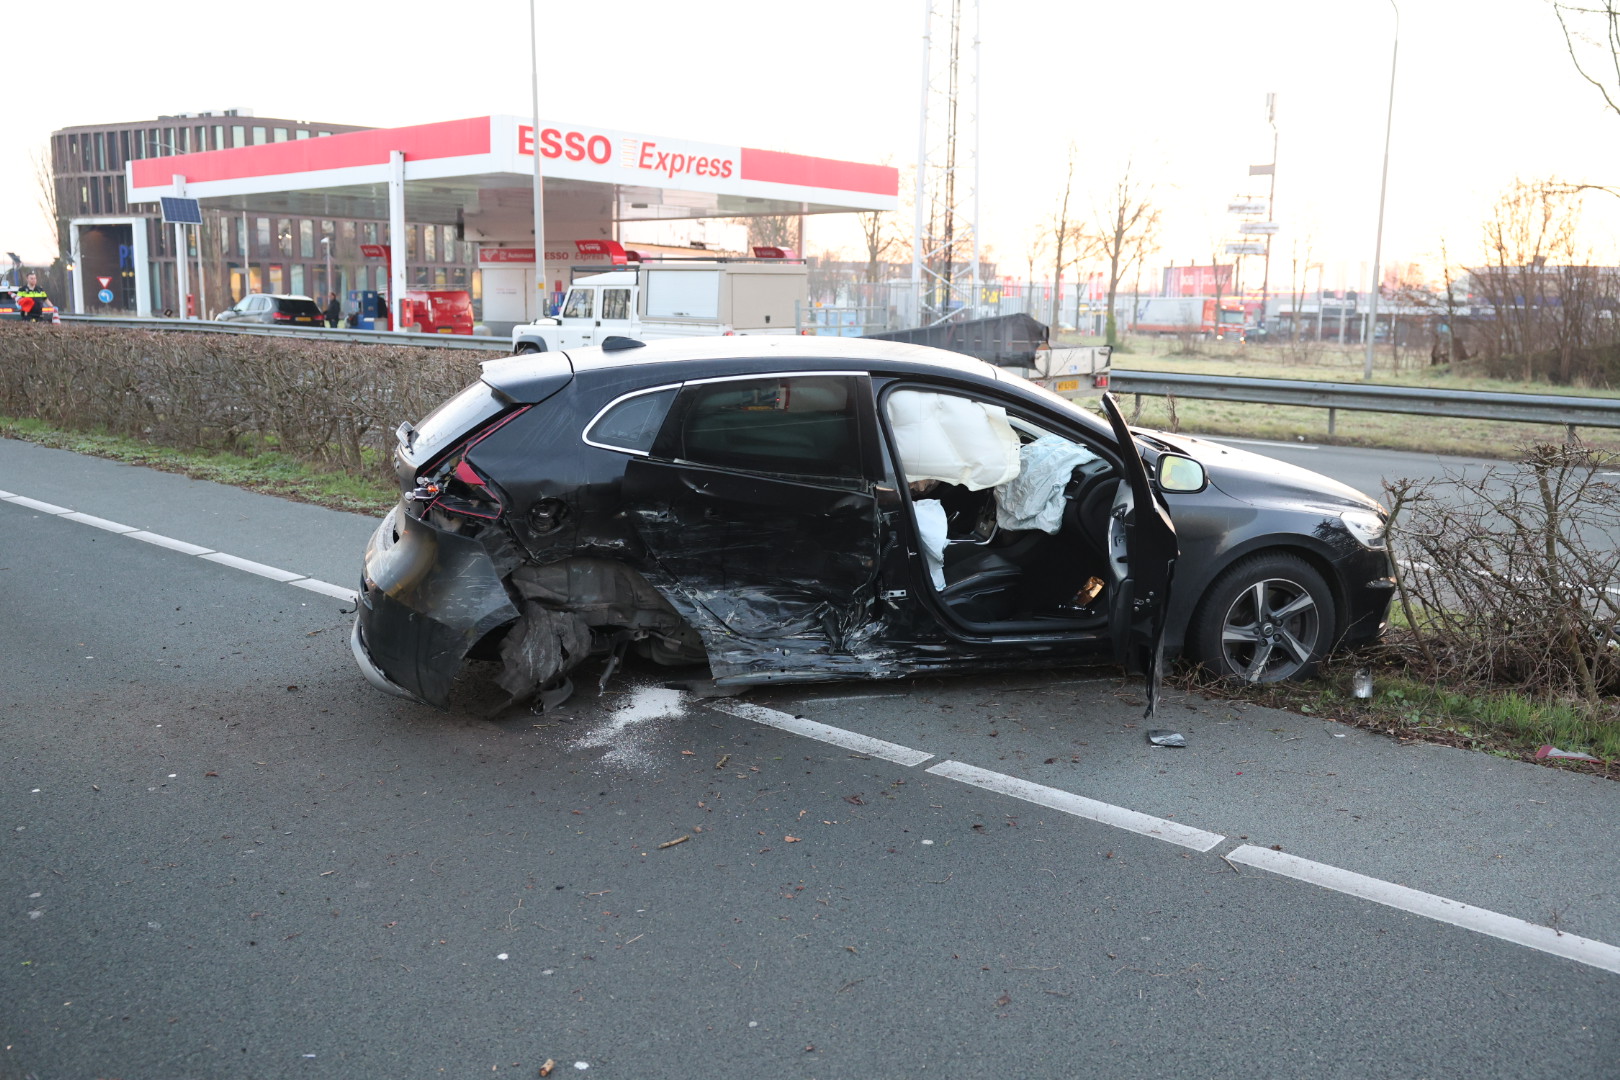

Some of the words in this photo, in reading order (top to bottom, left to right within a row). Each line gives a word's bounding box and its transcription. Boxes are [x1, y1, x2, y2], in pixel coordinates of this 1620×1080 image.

[518, 125, 612, 165] ESSO
[638, 141, 733, 178] Express
[545, 251, 569, 260] ESSO
